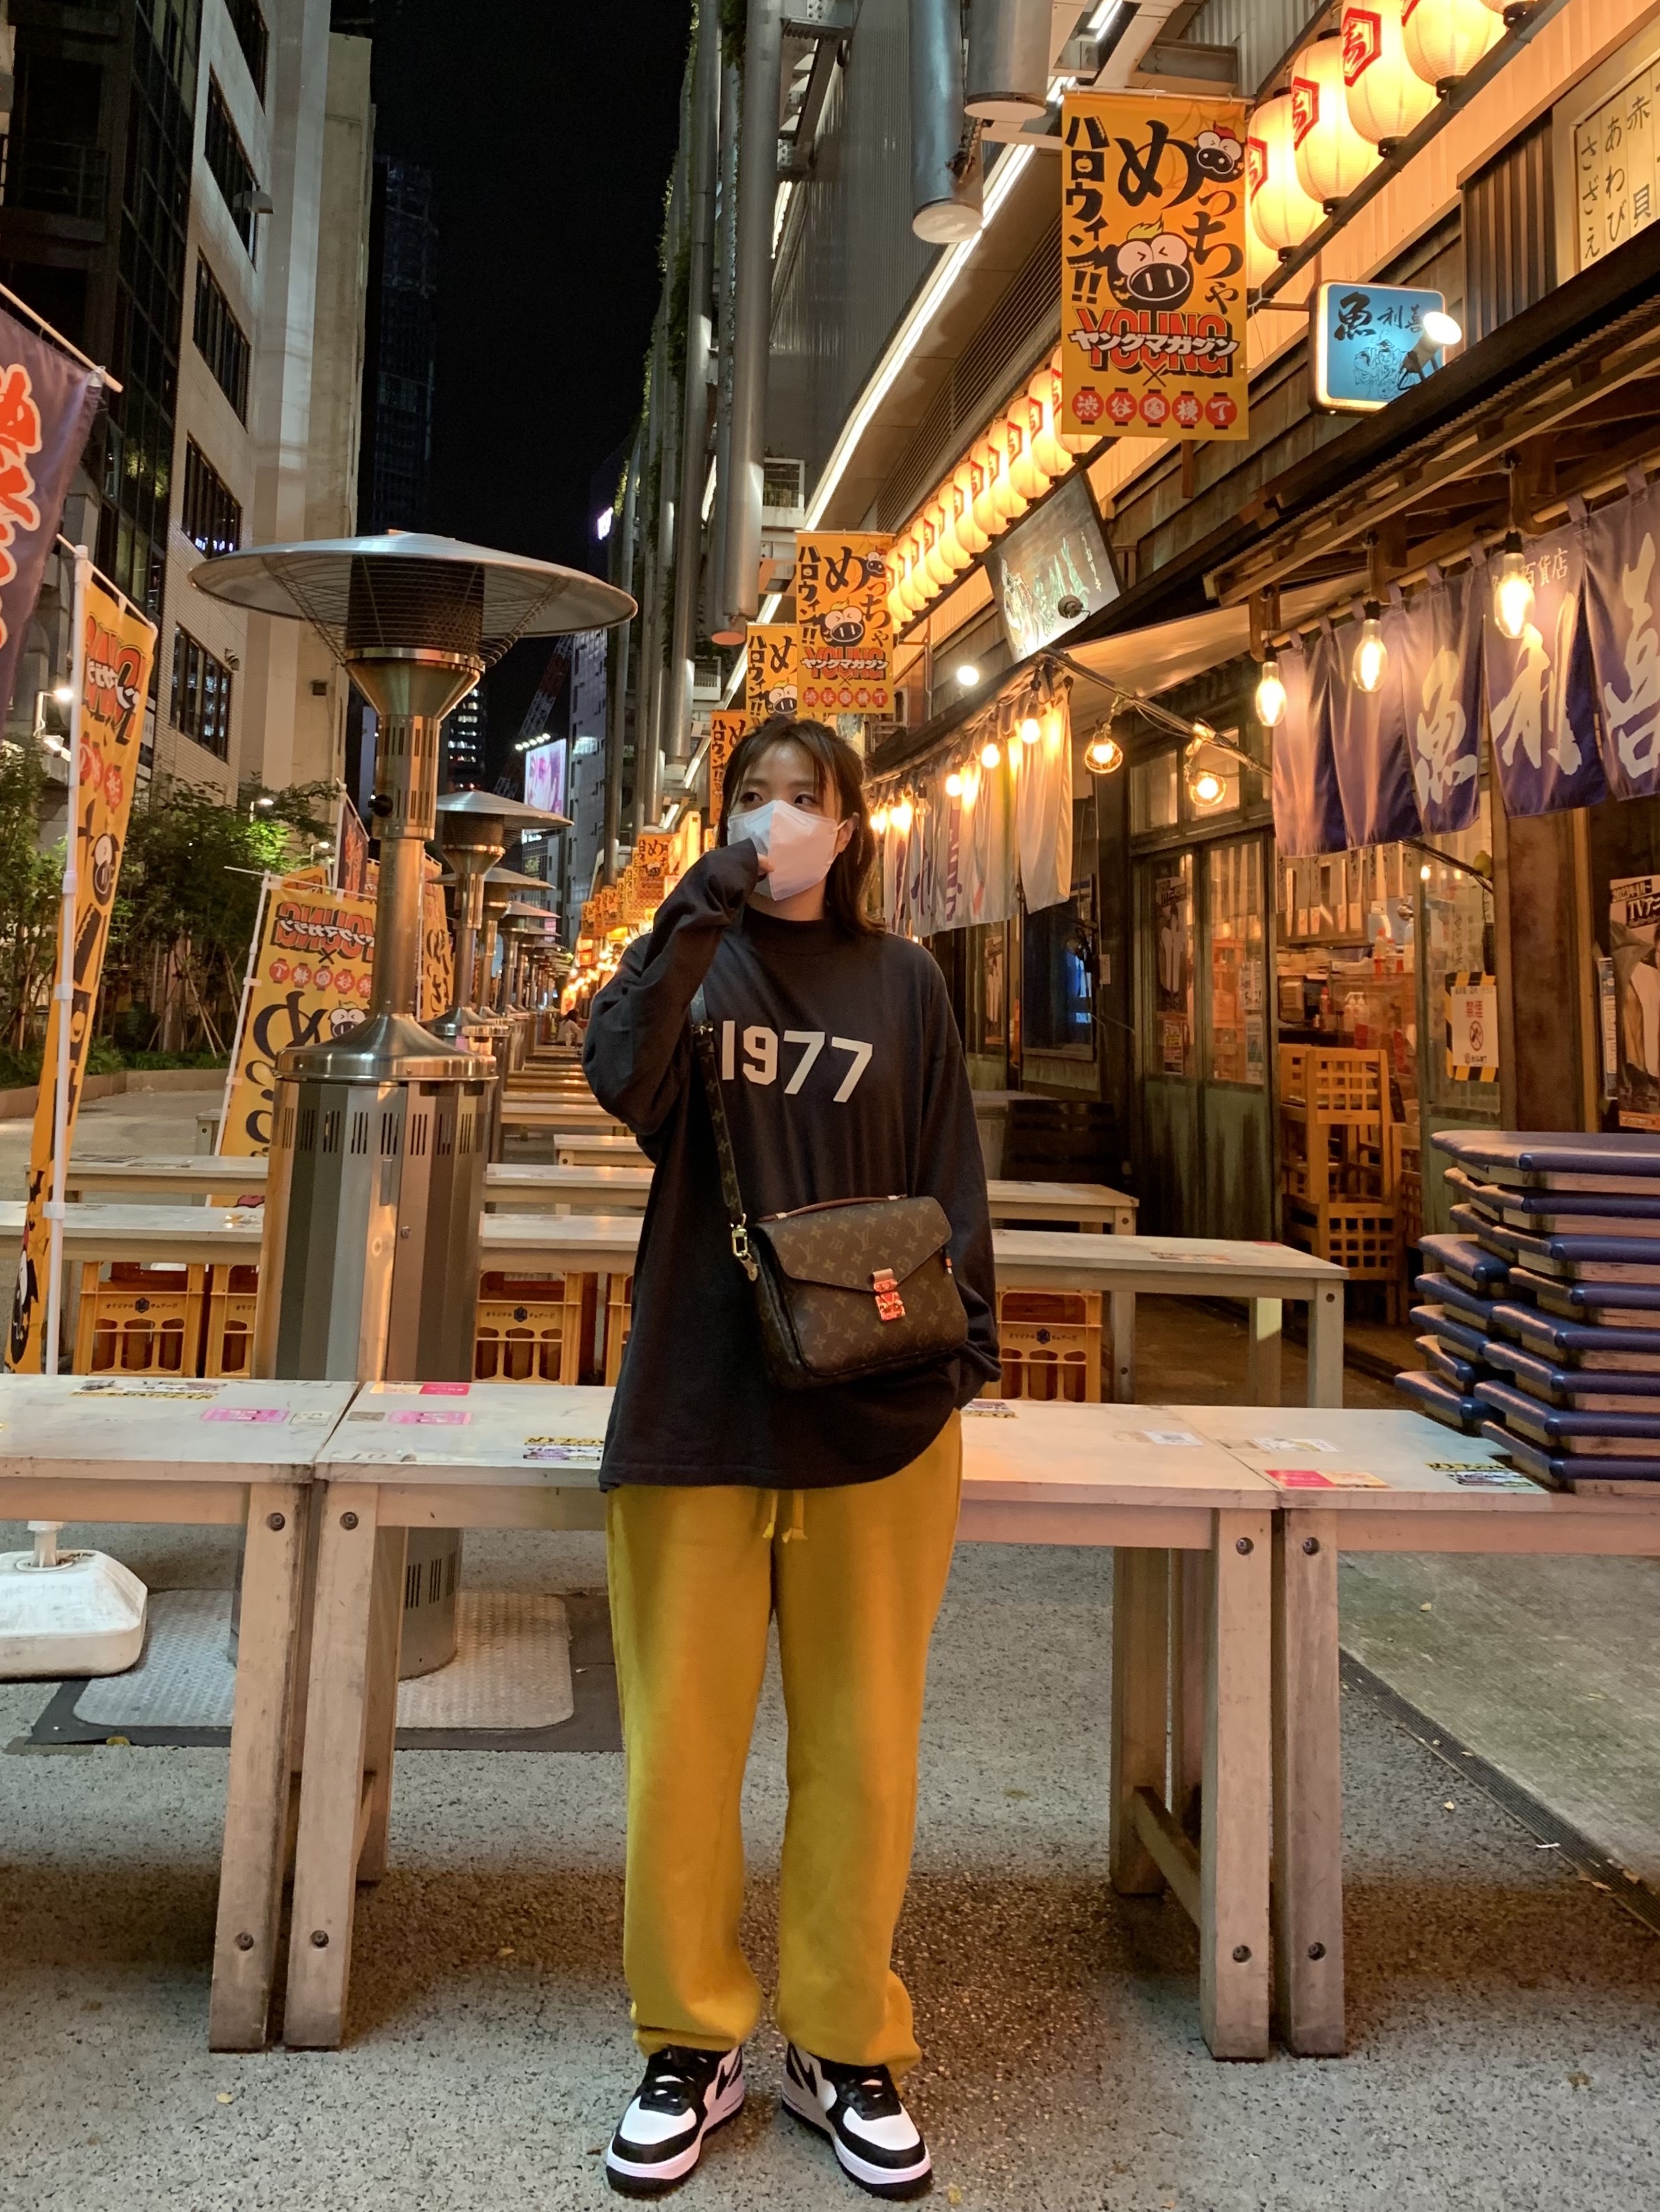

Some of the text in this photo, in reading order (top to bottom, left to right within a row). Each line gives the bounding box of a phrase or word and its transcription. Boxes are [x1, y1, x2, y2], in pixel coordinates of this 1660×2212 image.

[1581, 136, 1600, 260] さざえ
[1604, 116, 1627, 242] あわび
[1627, 95, 1652, 228] 赤貝
[1070, 329, 1239, 358] ヤングマガジン
[721, 1020, 873, 1103] 1977
